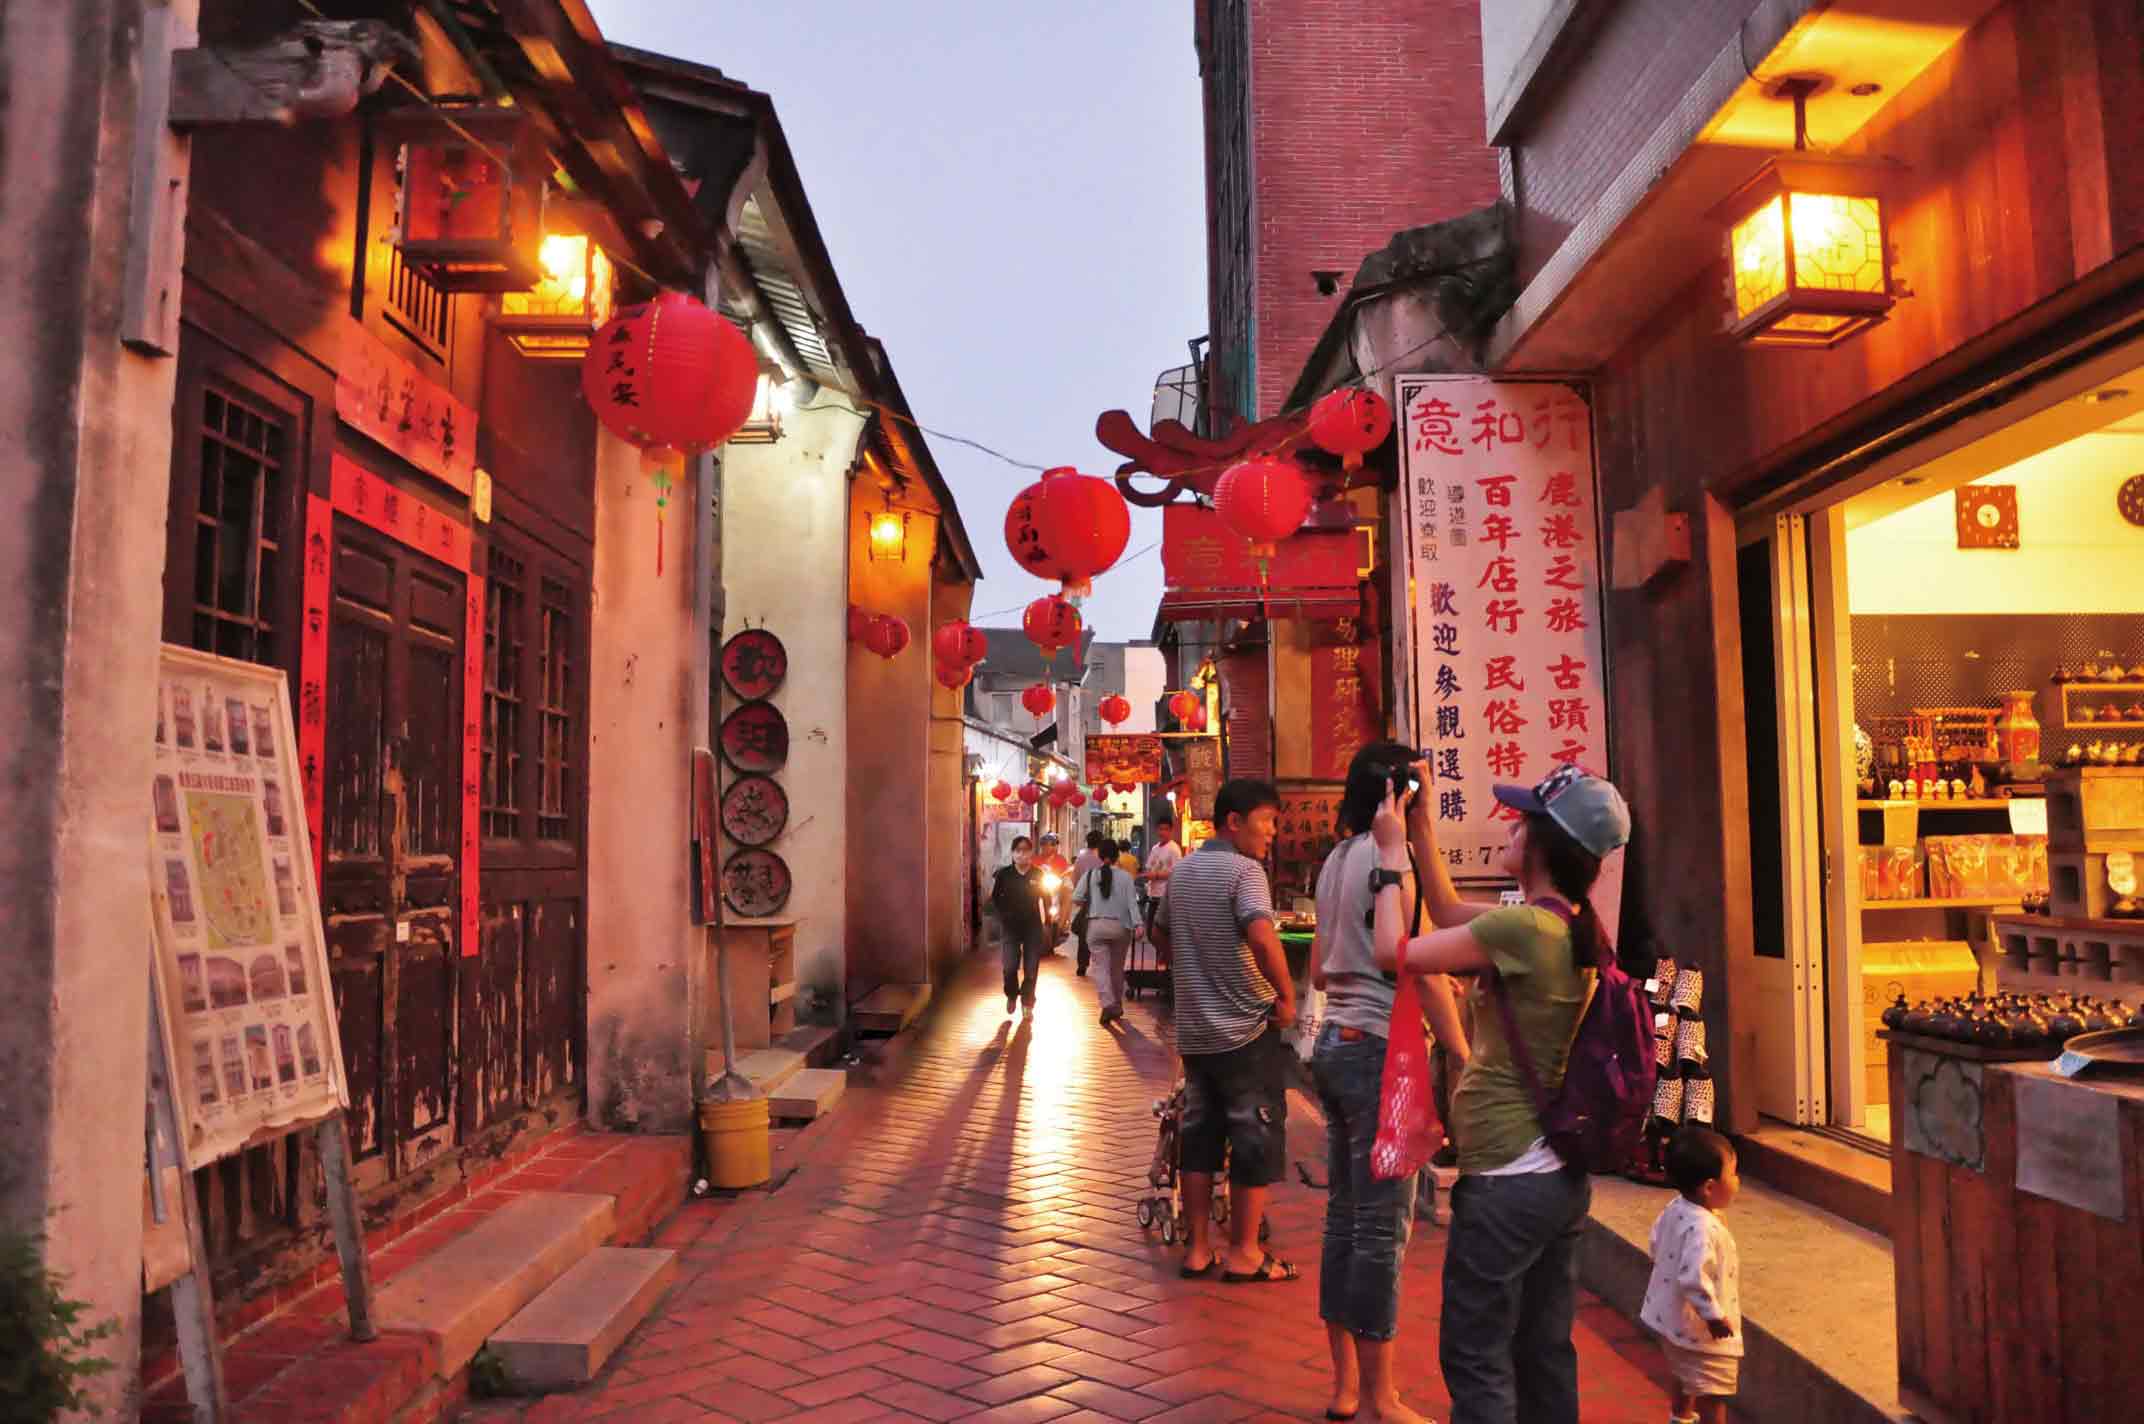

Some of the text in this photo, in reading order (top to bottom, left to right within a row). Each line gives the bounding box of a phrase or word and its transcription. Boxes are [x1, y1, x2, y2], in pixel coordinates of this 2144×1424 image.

[1412, 397, 1580, 456] 意和行
[1475, 474, 1525, 634] 百年店行
[1537, 471, 1589, 633] 鹿港之旅
[1430, 581, 1467, 823] 歡迎參觀選購
